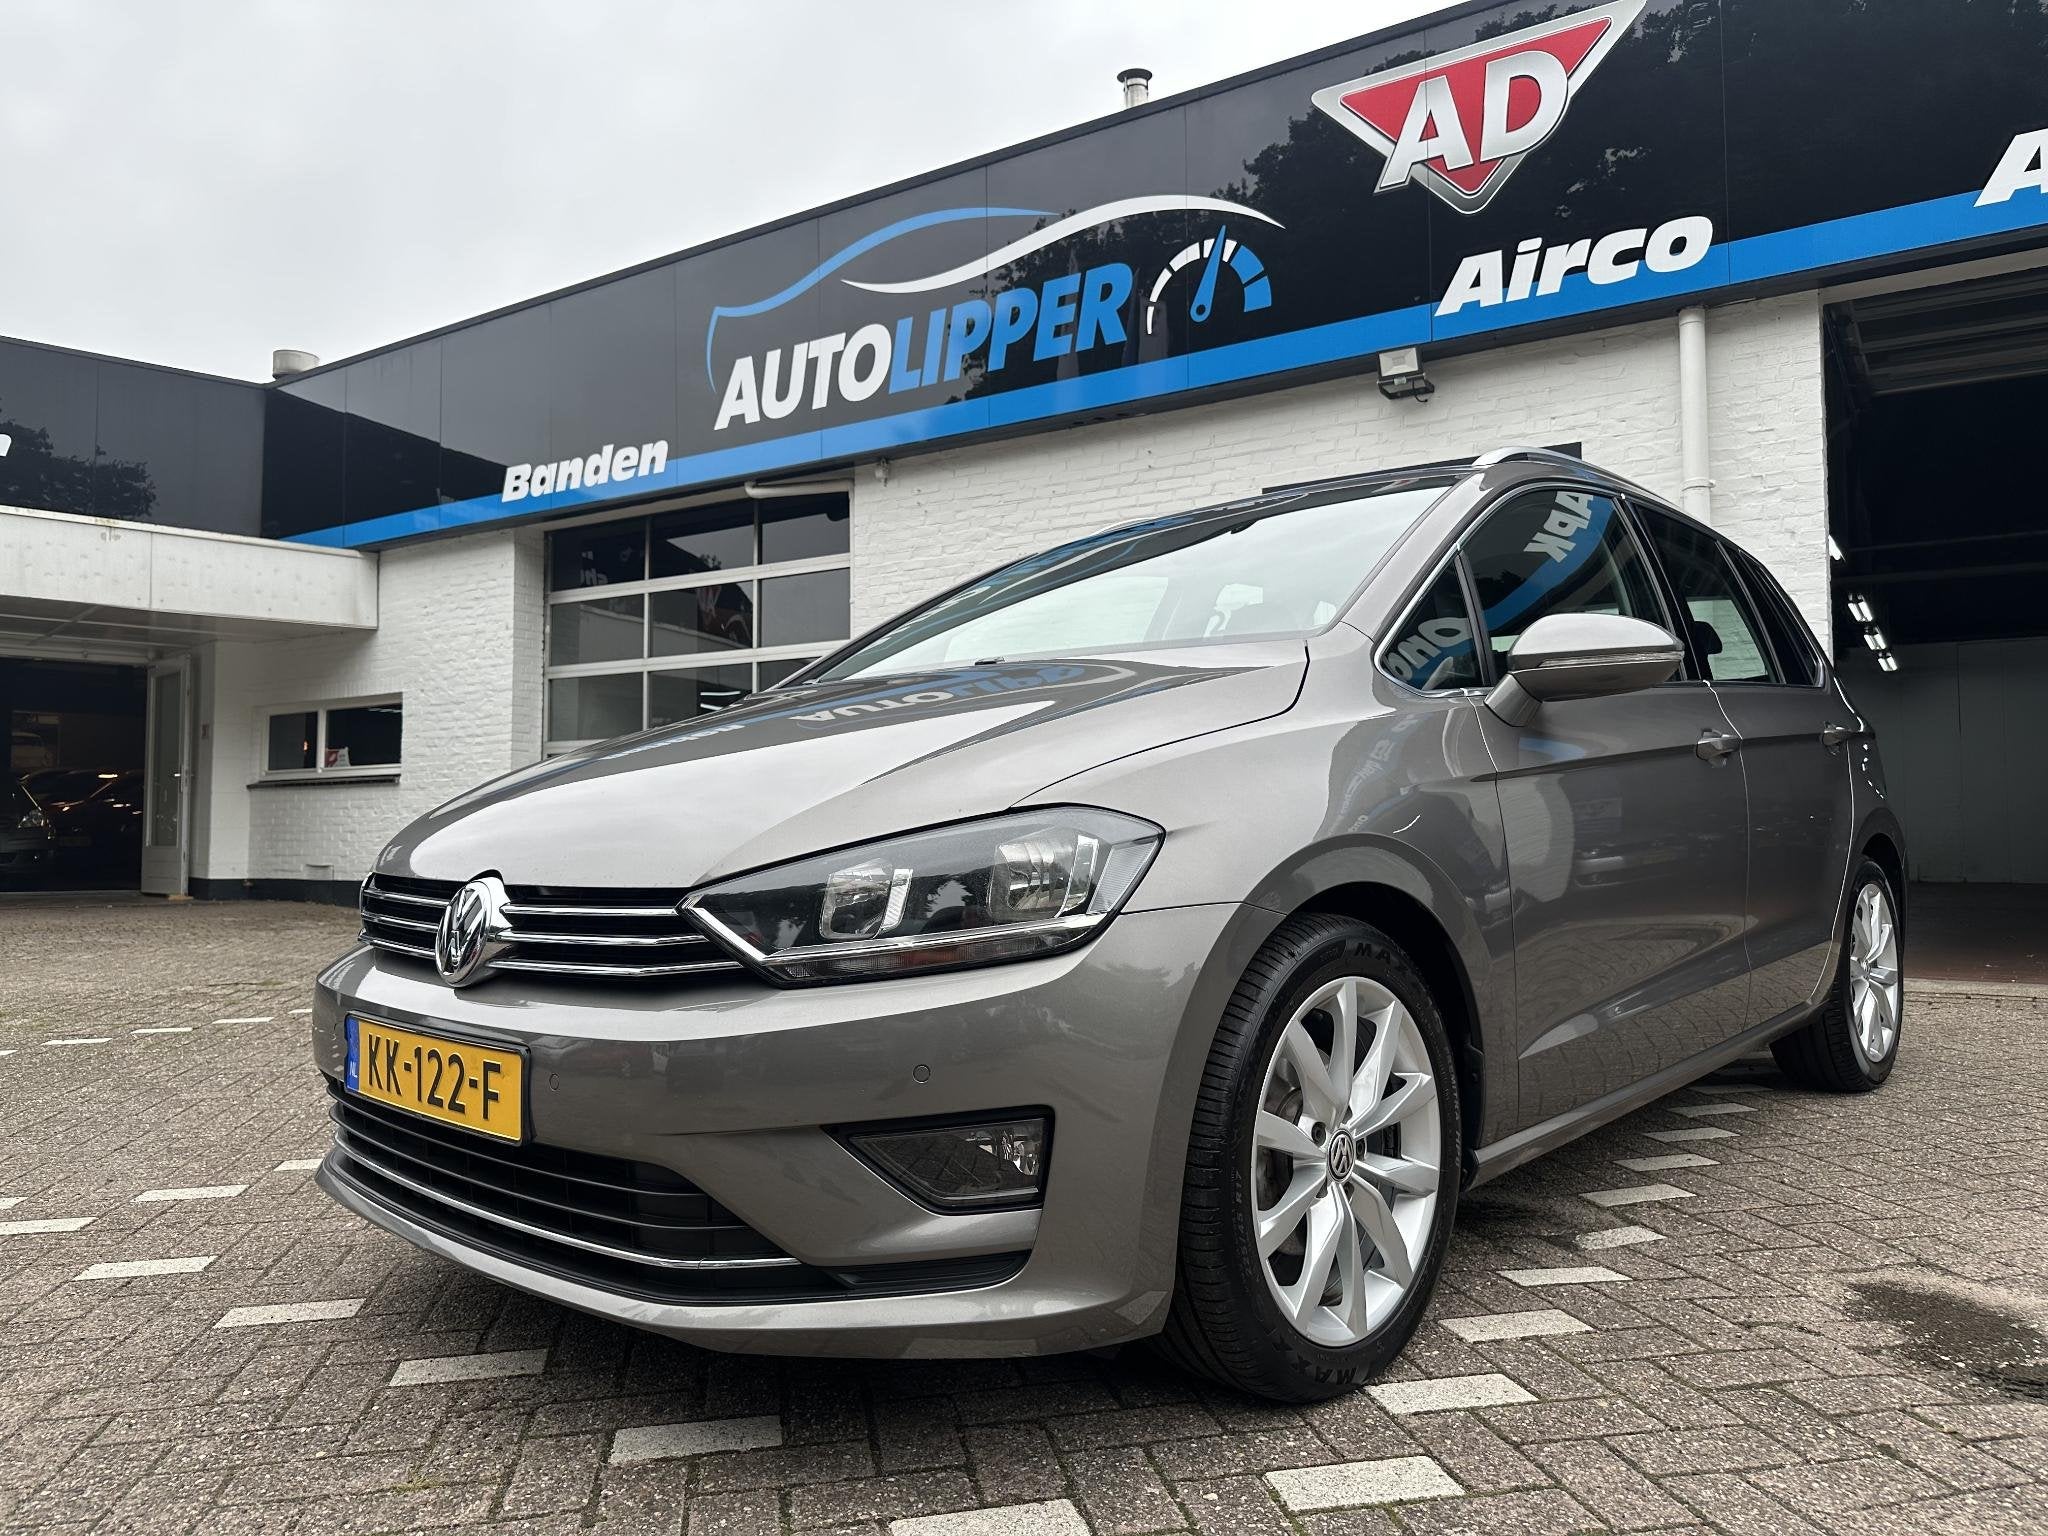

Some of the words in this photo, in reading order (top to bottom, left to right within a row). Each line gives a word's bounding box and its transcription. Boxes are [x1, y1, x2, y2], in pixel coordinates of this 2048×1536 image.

[1380, 50, 1568, 190] AD
[1434, 216, 1713, 317] Airco
[714, 263, 1133, 430] AUTOLIPPER
[502, 440, 668, 503] Banden
[368, 1033, 501, 1120] KK-122-F
